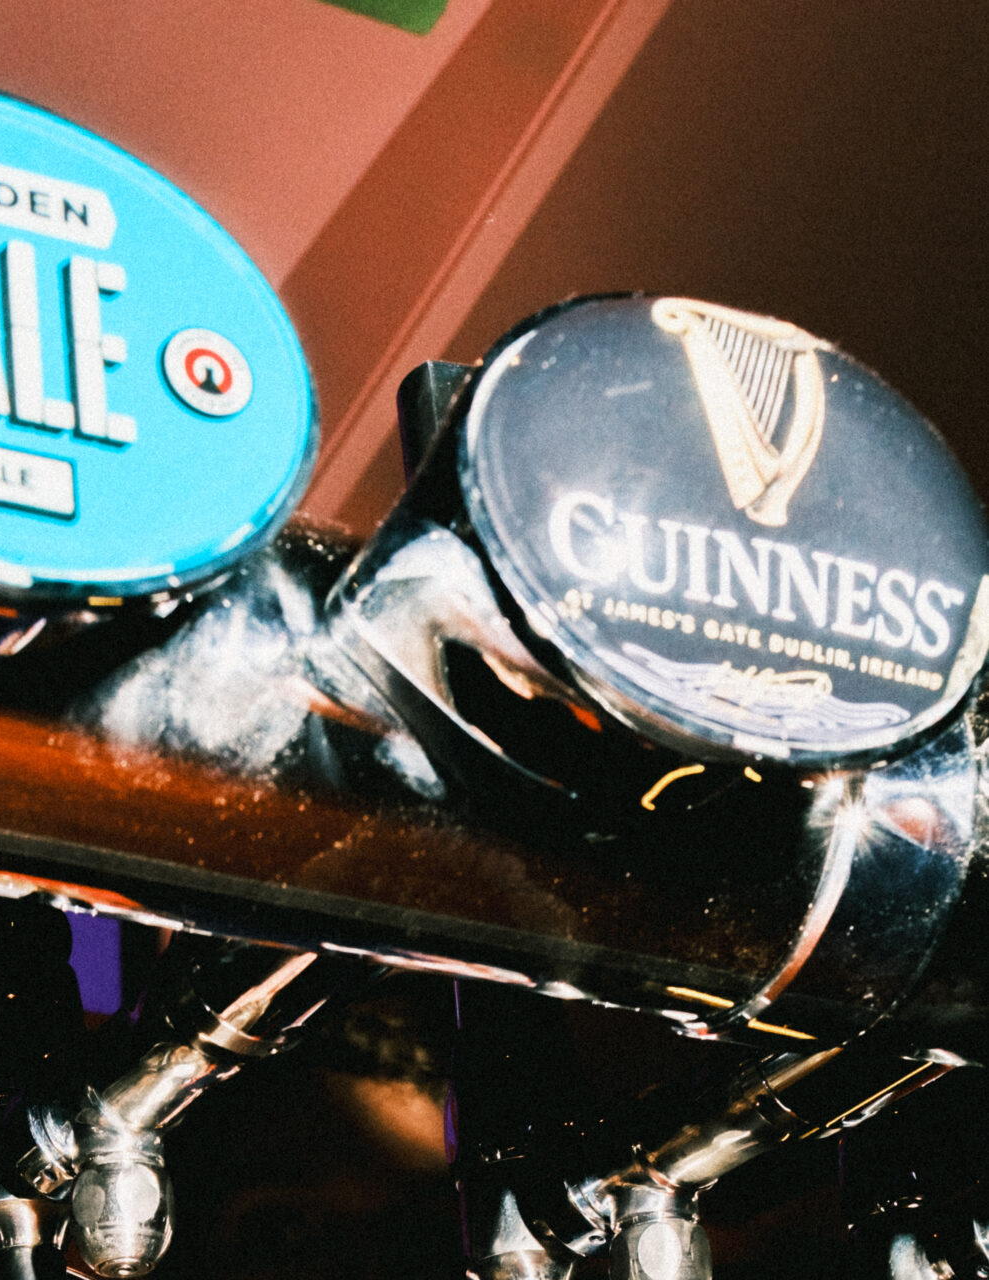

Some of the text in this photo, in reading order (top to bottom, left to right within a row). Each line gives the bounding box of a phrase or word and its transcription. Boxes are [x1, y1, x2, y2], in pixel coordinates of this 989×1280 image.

[548, 490, 965, 658] GUINNESS
[703, 619, 762, 650] GATE
[860, 654, 945, 692] IRELAND
